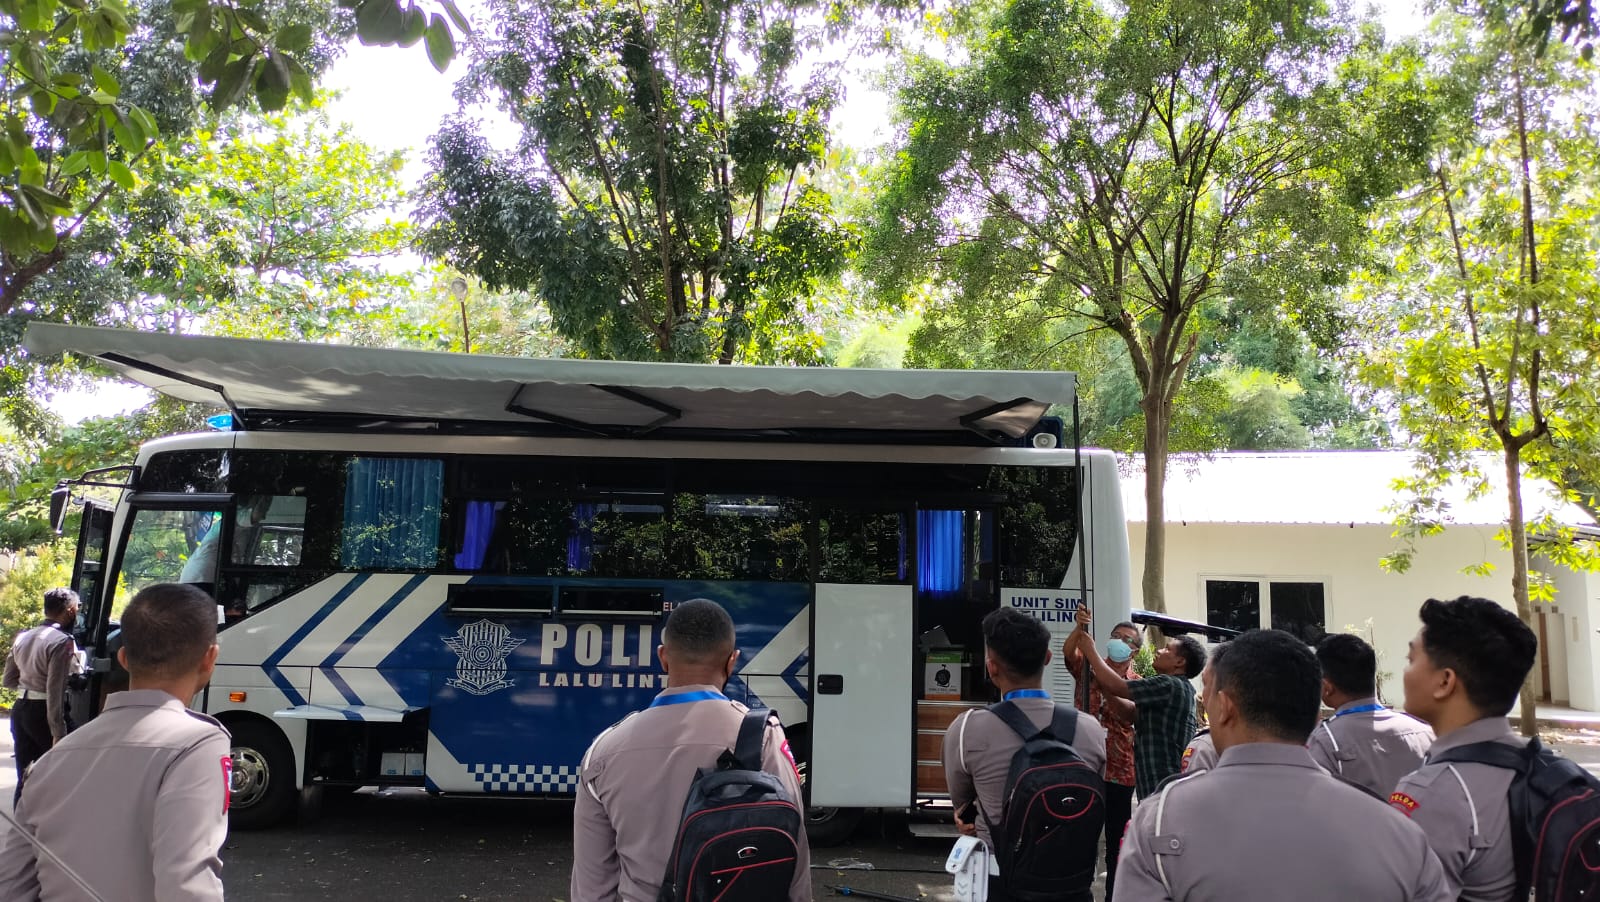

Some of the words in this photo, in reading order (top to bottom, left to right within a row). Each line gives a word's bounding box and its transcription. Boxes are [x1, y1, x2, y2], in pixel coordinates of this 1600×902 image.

[1012, 597, 1049, 608] UNIT
[1055, 598, 1082, 609] SIM
[540, 623, 667, 666] POLI
[539, 672, 603, 687] LALU
[612, 673, 669, 689] LINT
